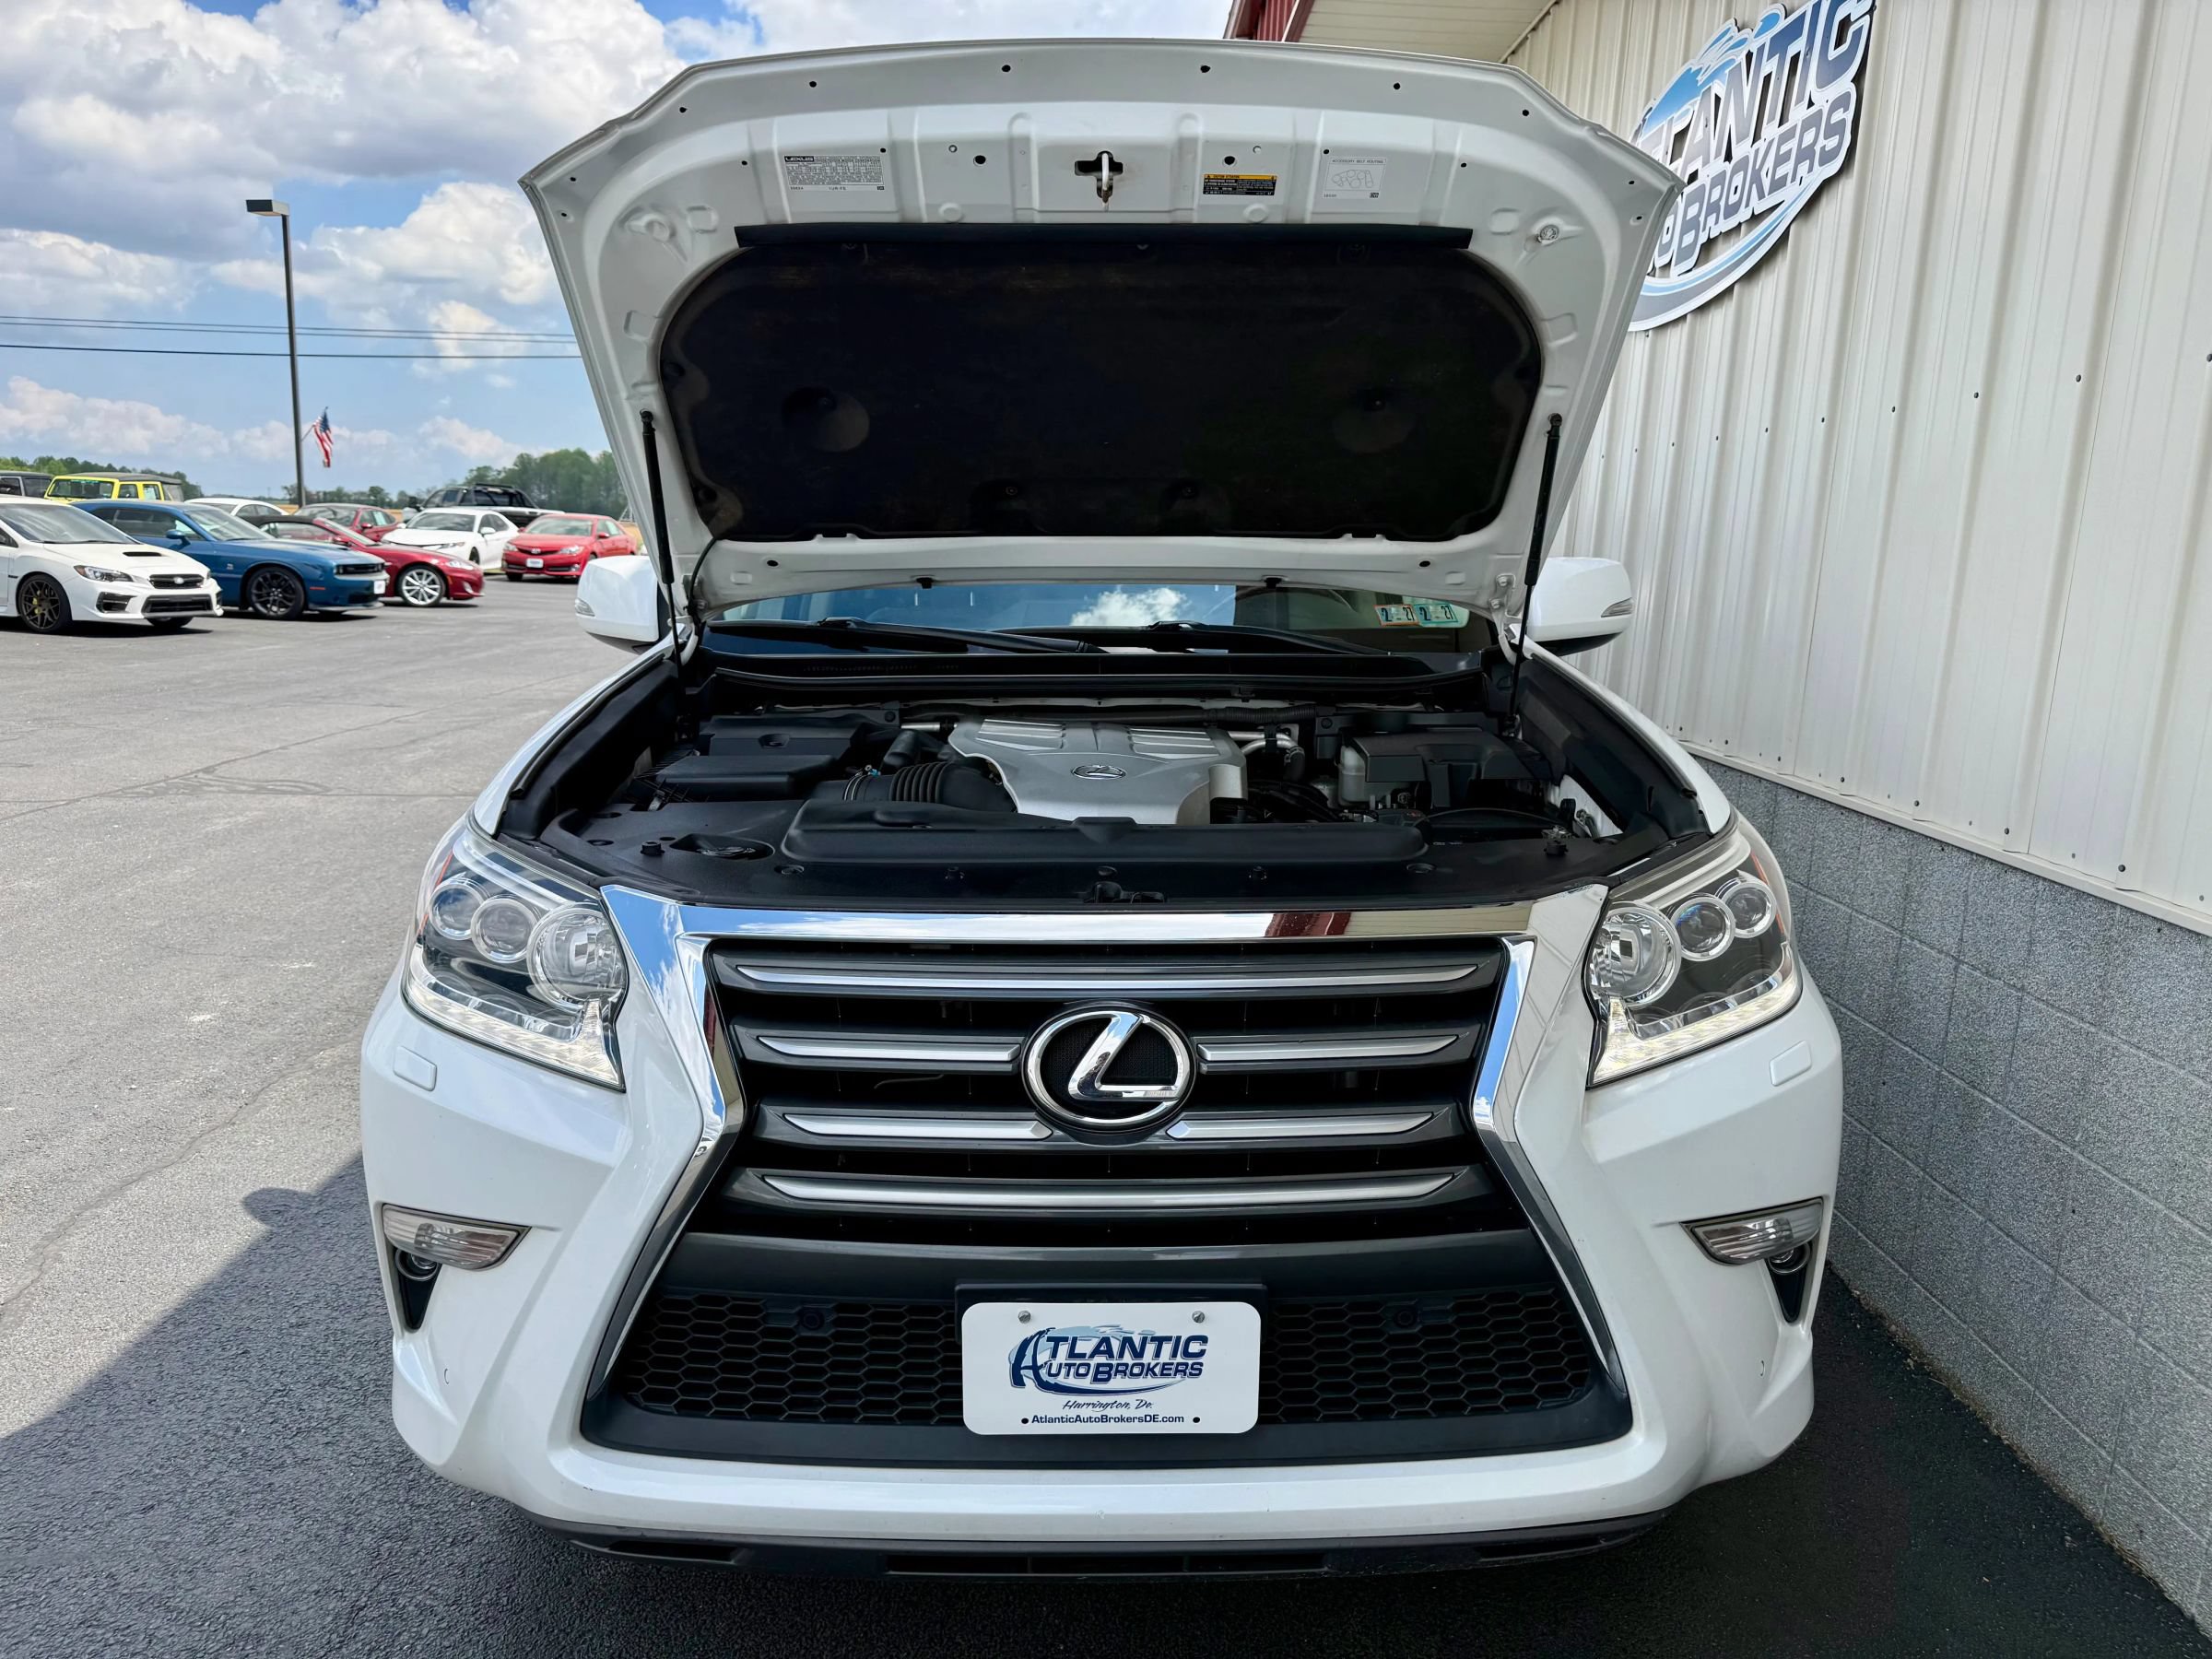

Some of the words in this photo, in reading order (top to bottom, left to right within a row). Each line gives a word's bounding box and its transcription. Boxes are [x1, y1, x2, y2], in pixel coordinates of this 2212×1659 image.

[1672, 89, 1853, 269] BROKERS
[1010, 1327, 1209, 1388] ATLANTIC
[1031, 1413, 1185, 1425] AtlanticAutoBrokersDE.com
[1062, 1399, 1132, 1413] Harrington,
